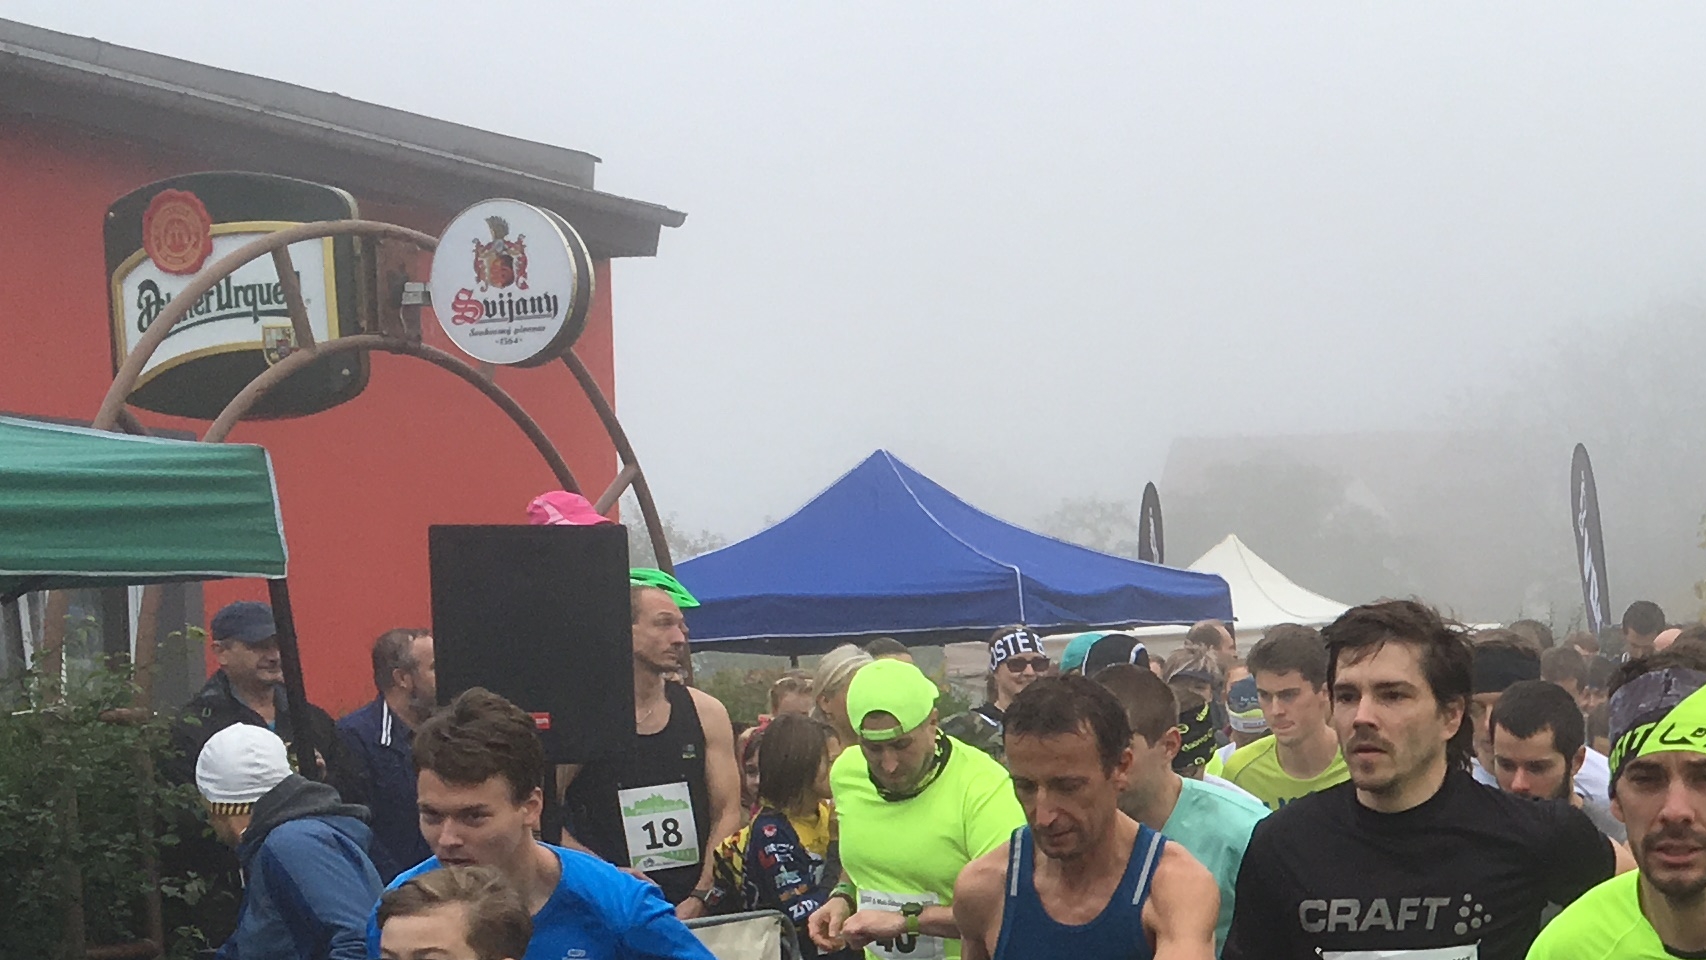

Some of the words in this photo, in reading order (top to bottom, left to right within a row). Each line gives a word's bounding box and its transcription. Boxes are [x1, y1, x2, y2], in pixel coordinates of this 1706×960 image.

[451, 287, 559, 326] Svijany
[641, 817, 684, 851] 18
[1298, 897, 1451, 934] CRAFT
